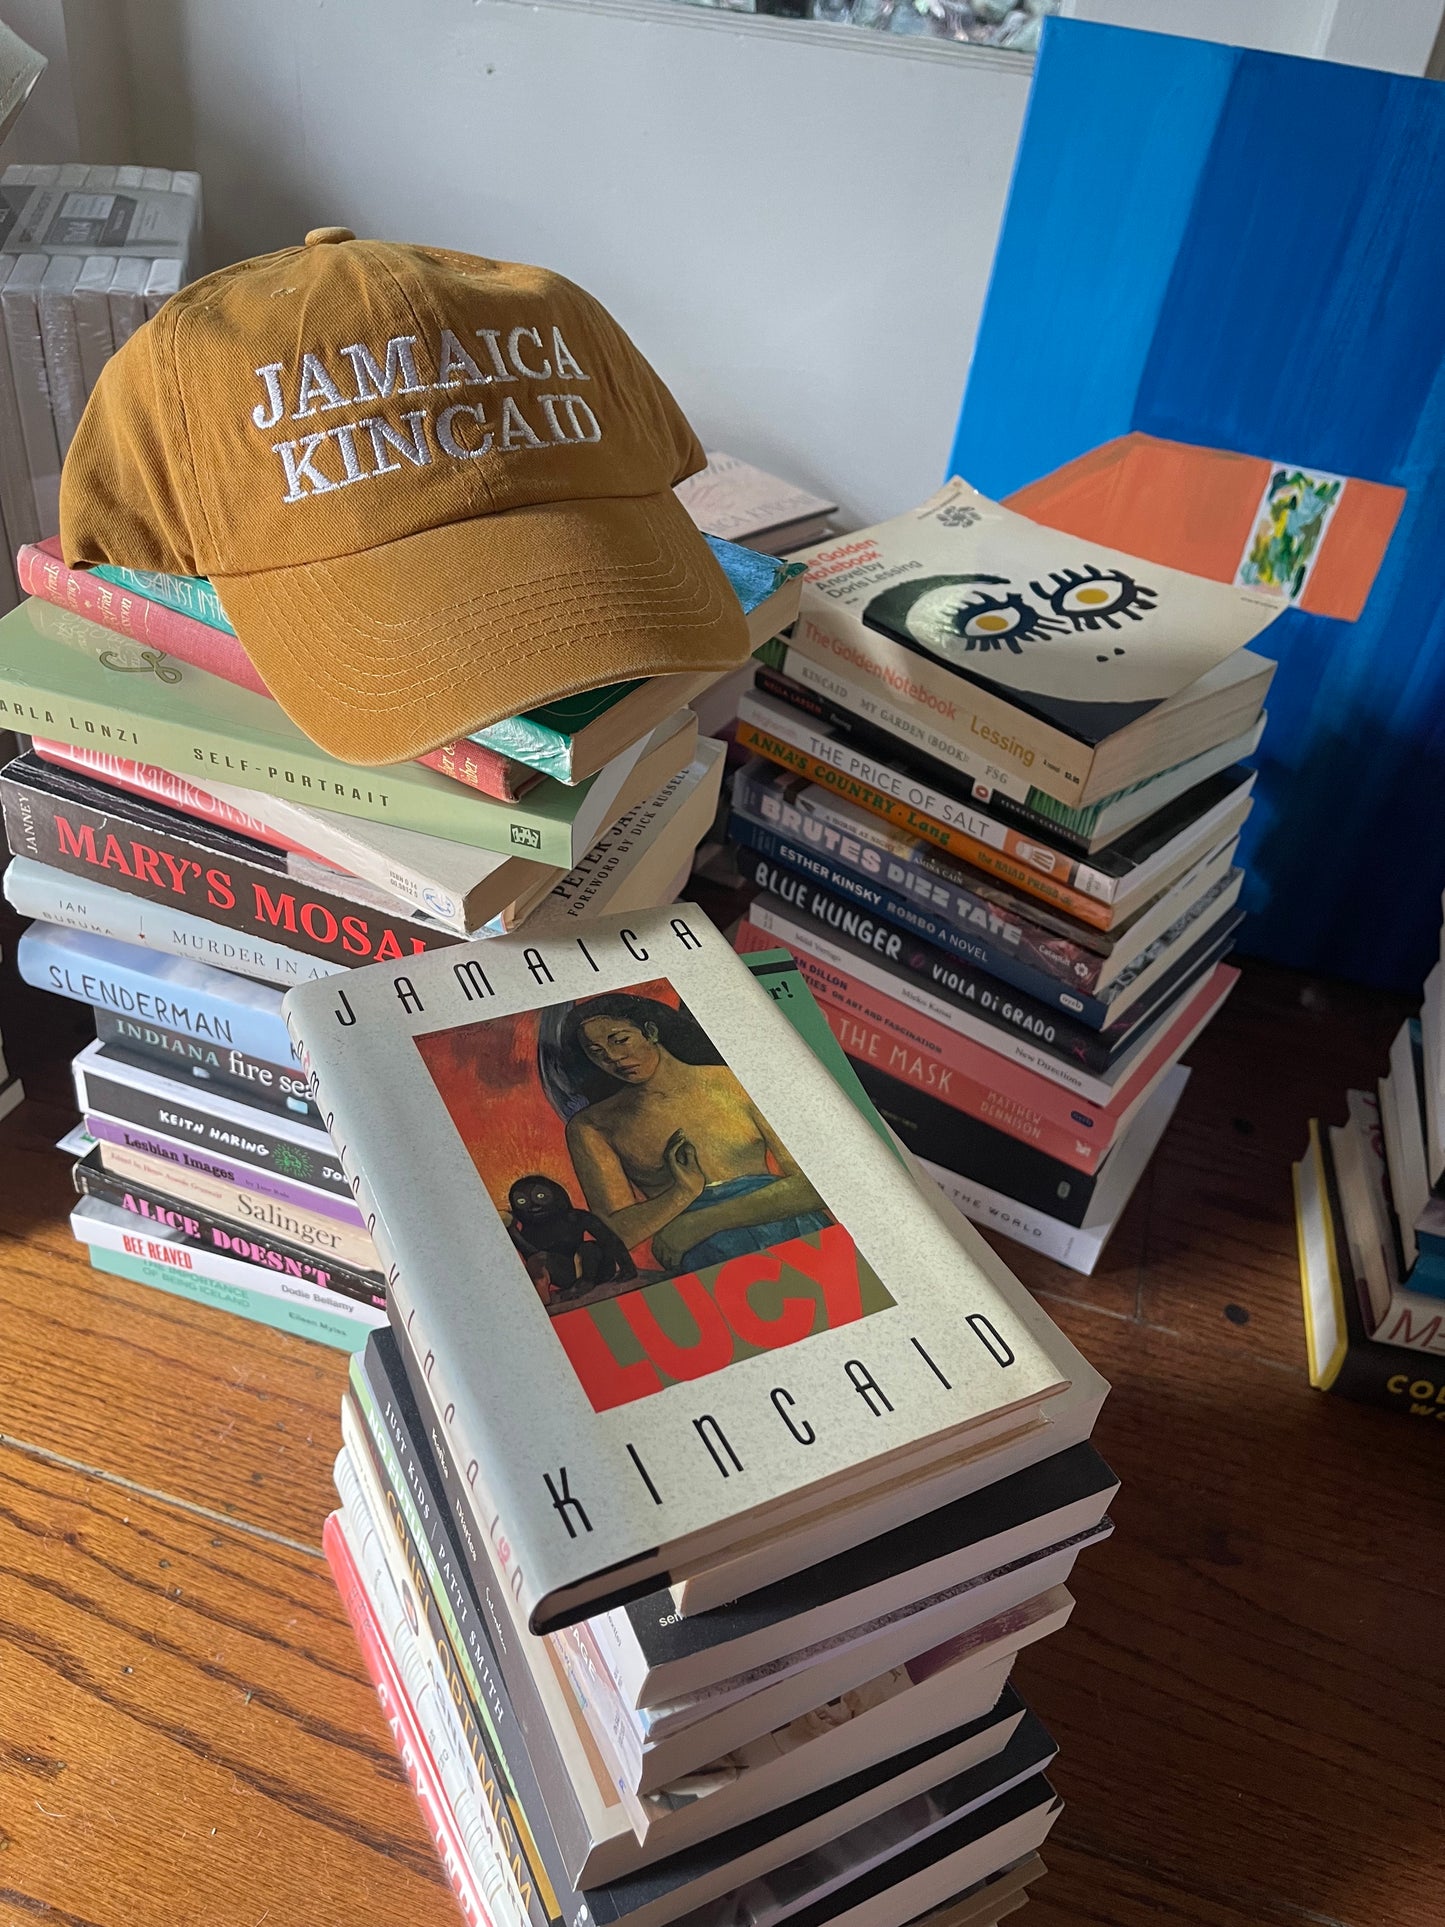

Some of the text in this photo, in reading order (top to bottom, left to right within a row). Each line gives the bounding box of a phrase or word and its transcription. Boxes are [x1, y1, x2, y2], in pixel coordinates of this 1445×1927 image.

[252, 326, 590, 430] JAMAICA
[272, 395, 601, 503] KINCAID
[831, 636, 883, 681] Golden
[882, 662, 958, 721] Notebook
[70, 717, 139, 745] LONZI
[193, 747, 389, 807] SELF-PORTRAIT
[880, 706, 926, 740] GARDEN
[985, 764, 1009, 786] FSG
[970, 716, 1035, 768] Lessing
[749, 732, 951, 846] ANNA'S COUNTRY Lang
[809, 737, 989, 838] THE PRICE OF SALT
[54, 815, 236, 910] MARY'S
[567, 768, 690, 918] FOREWORD BY DICK RUSSELL
[760, 794, 882, 873] BRUTES
[956, 898, 1023, 945] TATE
[59, 900, 87, 916] IAN
[172, 929, 265, 967] MURDER
[275, 957, 299, 974] IN
[780, 845, 988, 963] ESTHER KINSKY ROMBO A NOVEL
[334, 918, 703, 1027] JAMAICA
[755, 861, 808, 910] BLUE
[811, 892, 903, 961] HUNGER
[932, 963, 981, 1000] VIOLA
[1002, 1003, 1056, 1043] GRADO
[809, 964, 849, 991] DILLON
[49, 964, 235, 1043] SLENDERMAN
[115, 1019, 221, 1067] INDIANA
[228, 1051, 273, 1087] fire
[839, 1018, 954, 1094] THE MASK
[1036, 1056, 1083, 1088] Directions
[159, 1109, 206, 1134] KEITH
[209, 1127, 270, 1157] HARING
[980, 1101, 1042, 1140] DENNISON
[986, 1091, 1042, 1125] MATTHEW
[124, 1132, 182, 1163] Lesbian
[183, 1153, 236, 1182] Images
[121, 1193, 332, 1289] ALICE DOESN'T
[237, 1192, 343, 1251] Salinger
[952, 1188, 981, 1208] THE
[988, 1206, 1042, 1237] WORLD
[123, 1234, 145, 1255] BEE
[148, 1242, 193, 1271] REAVED
[281, 1283, 311, 1303] Dodie
[312, 1291, 354, 1314] Bellamy
[550, 1222, 864, 1413] LUCY
[543, 1313, 1015, 1539] KINCAID
[367, 1408, 388, 1456] NO
[386, 1464, 437, 1580] FUTURE
[384, 1401, 408, 1455] JUST
[408, 1460, 430, 1520] KIDS
[437, 1544, 468, 1623] PATTI
[469, 1630, 504, 1723] SMITH
[437, 1639, 533, 1911] OPTIMISM
